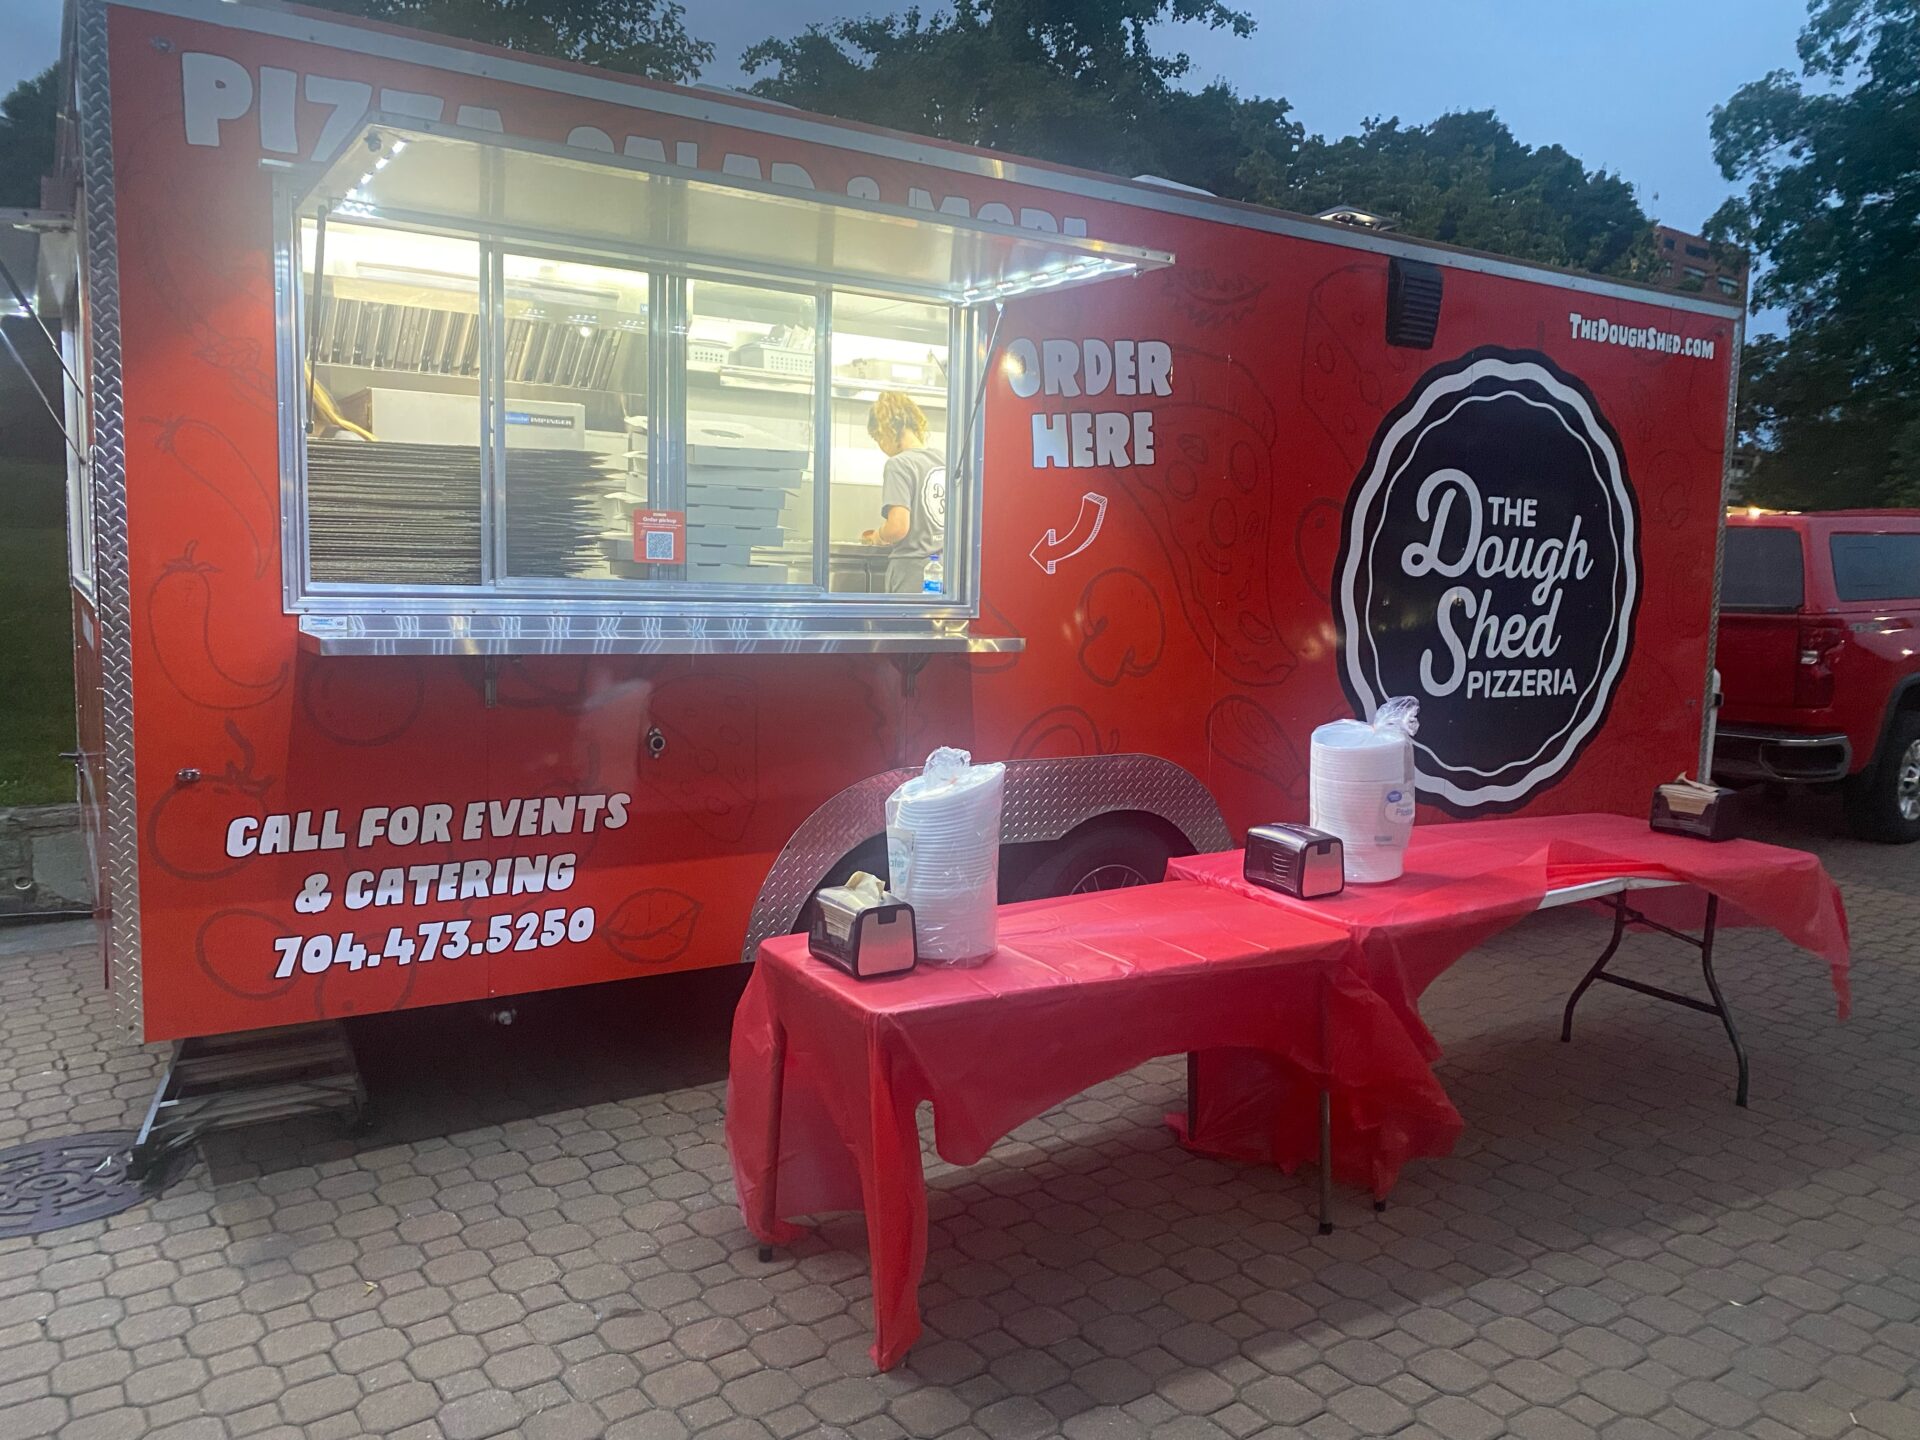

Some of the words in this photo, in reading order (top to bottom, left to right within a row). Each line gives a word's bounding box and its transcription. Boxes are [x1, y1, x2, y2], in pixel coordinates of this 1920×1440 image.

[1006, 338, 1173, 397] ORDER
[1031, 411, 1155, 468] HERE
[1401, 468, 1594, 606] Dough
[1488, 496, 1538, 527] THE
[1419, 586, 1563, 697] Shed
[1466, 668, 1577, 699] PIZZERIA
[226, 811, 346, 857] CALL
[358, 807, 453, 847] FOR
[462, 793, 631, 841] EVENTS
[294, 873, 333, 913] &
[344, 853, 577, 910] CATERING
[274, 906, 596, 979] 704.473.5250
